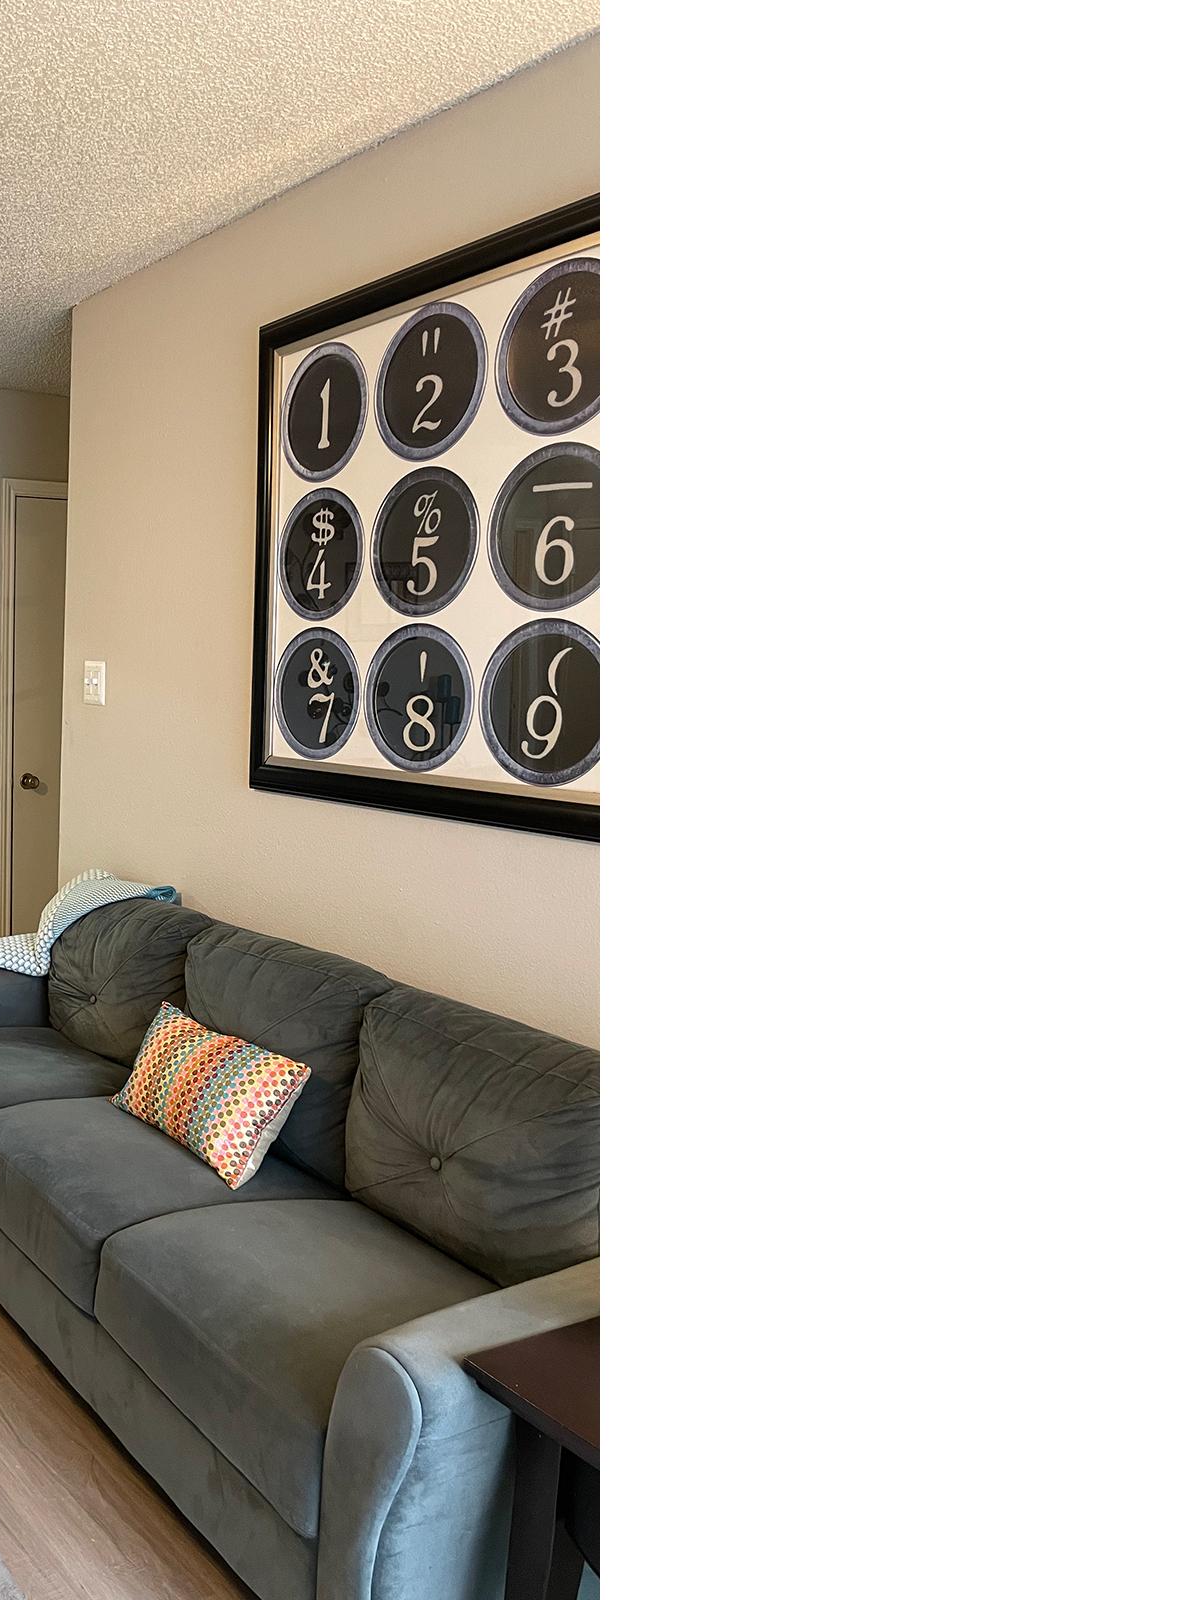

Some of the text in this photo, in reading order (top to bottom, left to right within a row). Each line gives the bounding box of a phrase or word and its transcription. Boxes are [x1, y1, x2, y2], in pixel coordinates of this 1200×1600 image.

[540, 287, 577, 340] #
[546, 338, 583, 408] 3
[317, 377, 330, 450] 1
[412, 374, 443, 434] 2
[311, 507, 335, 545] $
[413, 490, 442, 534] %
[306, 549, 332, 600] 4
[406, 535, 440, 596] 5
[534, 515, 575, 586] 6
[307, 648, 333, 688] &
[309, 692, 335, 744] 7
[402, 694, 436, 752] 8
[520, 695, 563, 760] 9
